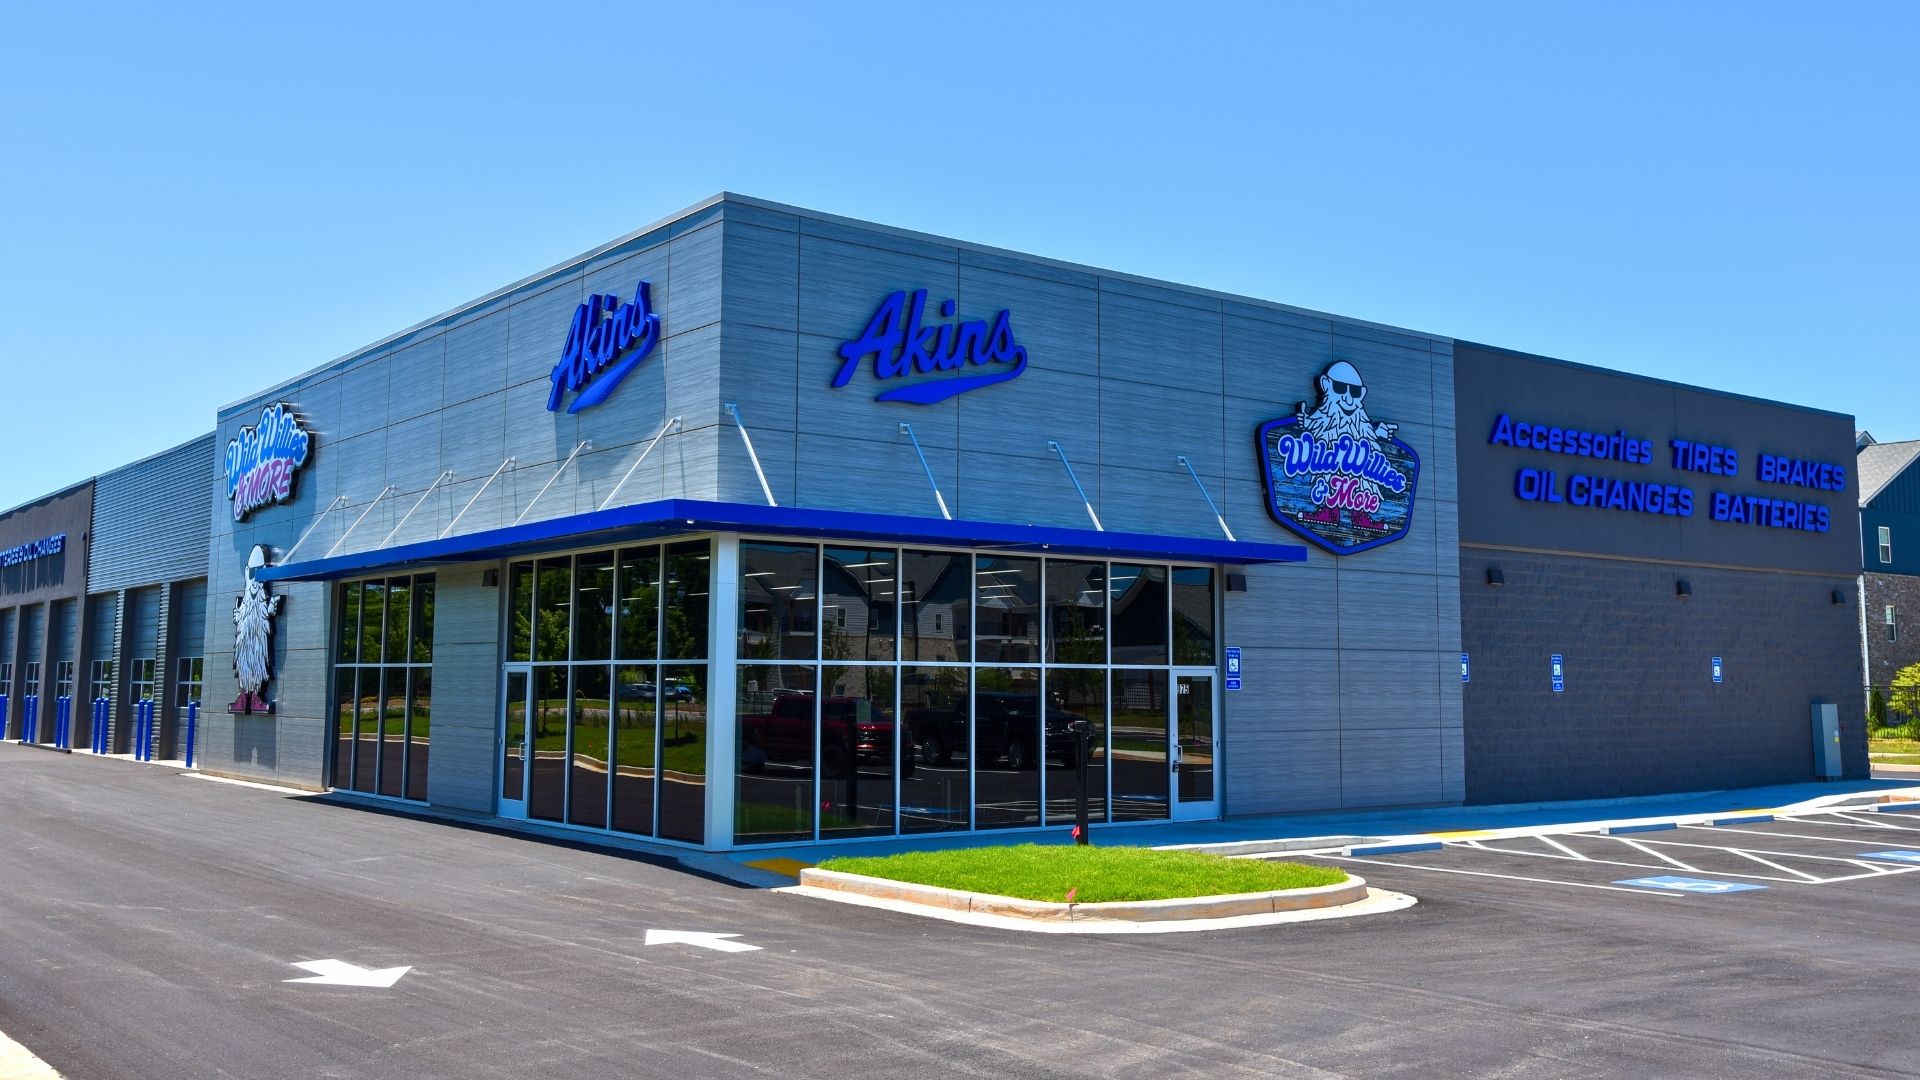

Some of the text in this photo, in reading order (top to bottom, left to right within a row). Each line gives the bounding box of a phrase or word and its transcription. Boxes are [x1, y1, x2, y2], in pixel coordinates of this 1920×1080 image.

[547, 280, 660, 413] Akins
[830, 289, 1027, 404] Akins
[226, 405, 308, 493] Wild Willies
[1280, 434, 1406, 491] Wild Willies
[1489, 413, 1845, 492] Accessories TIRES BRAKES
[1312, 477, 1379, 512] & More
[1515, 468, 1830, 533] OIL CHANGES BATTERIES
